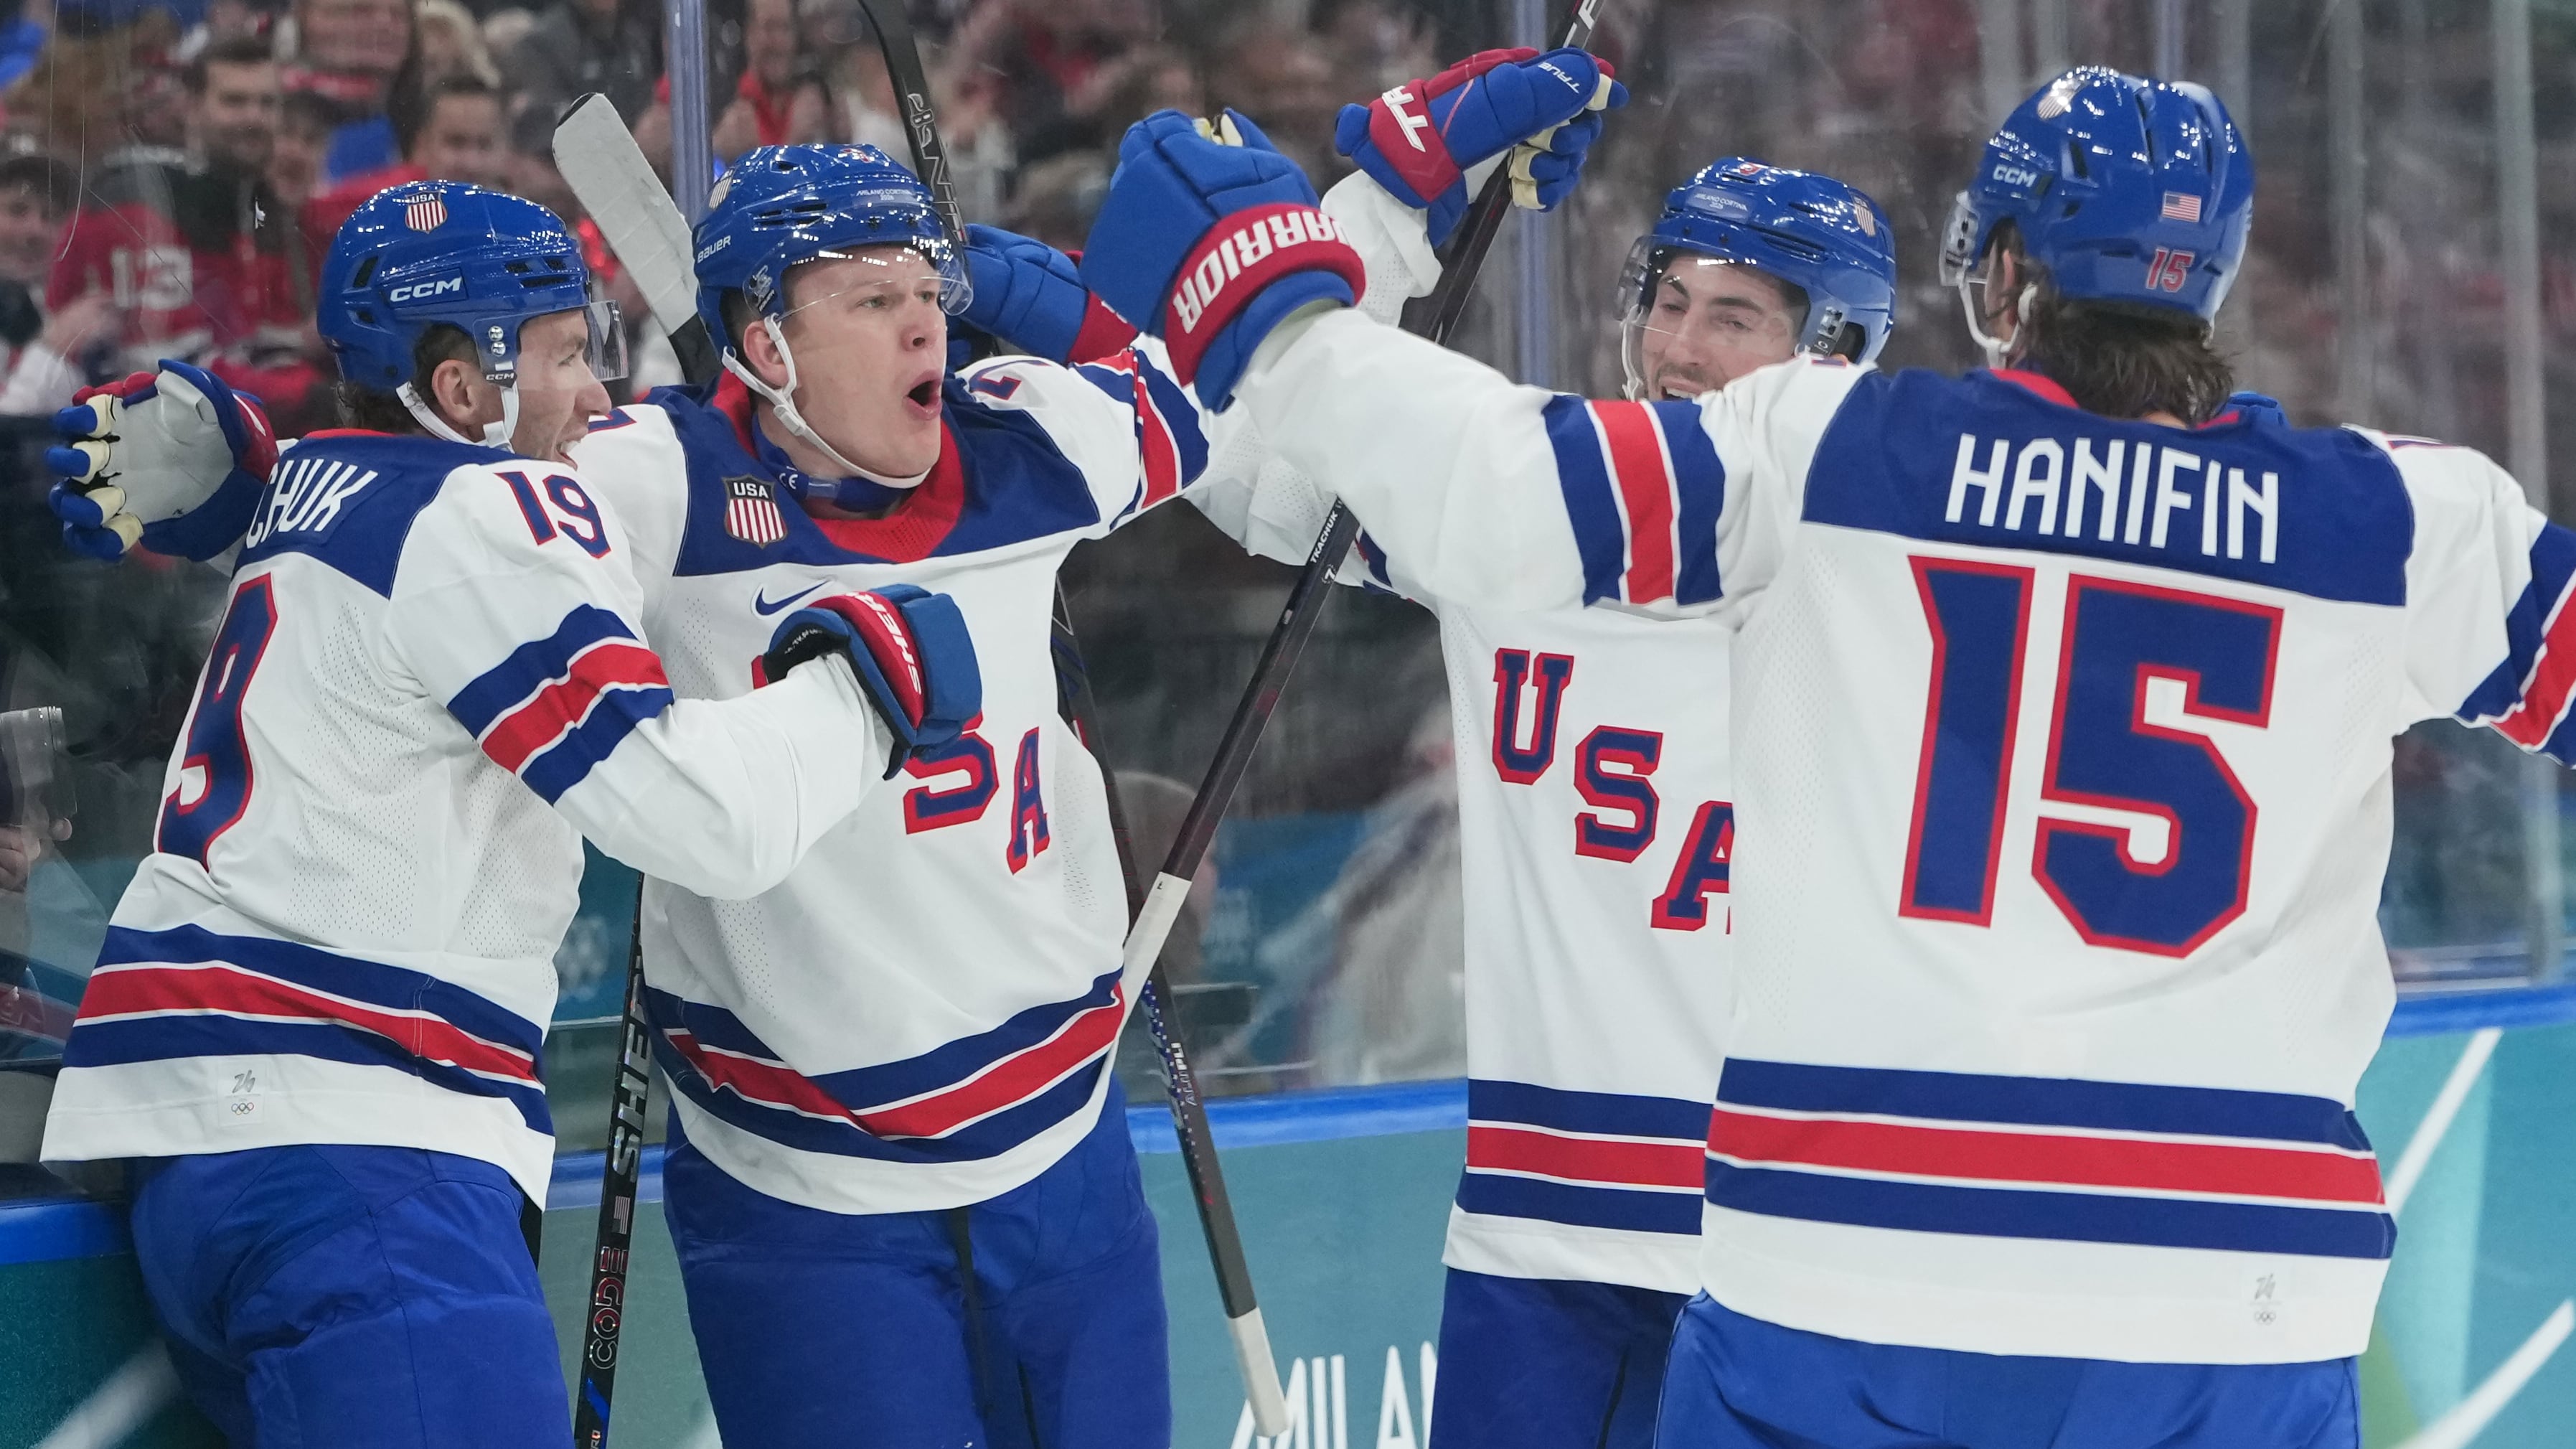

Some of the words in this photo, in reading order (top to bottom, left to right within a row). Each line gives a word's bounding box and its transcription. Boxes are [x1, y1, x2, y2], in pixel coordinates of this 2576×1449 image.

[1538, 62, 1580, 94] TRUE
[411, 193, 436, 204] USA
[1993, 163, 2038, 188] CCM
[390, 276, 463, 302] CCM
[2145, 247, 2195, 294] 15
[493, 470, 611, 559] 19
[733, 482, 770, 499] USA
[1945, 433, 2280, 563] HANIFIN
[1310, 511, 1338, 563] TKACHUK
[845, 591, 922, 695] SHER
[1898, 553, 2285, 960] 15
[1492, 647, 1735, 934] USA
[589, 1246, 629, 1370] CODE
